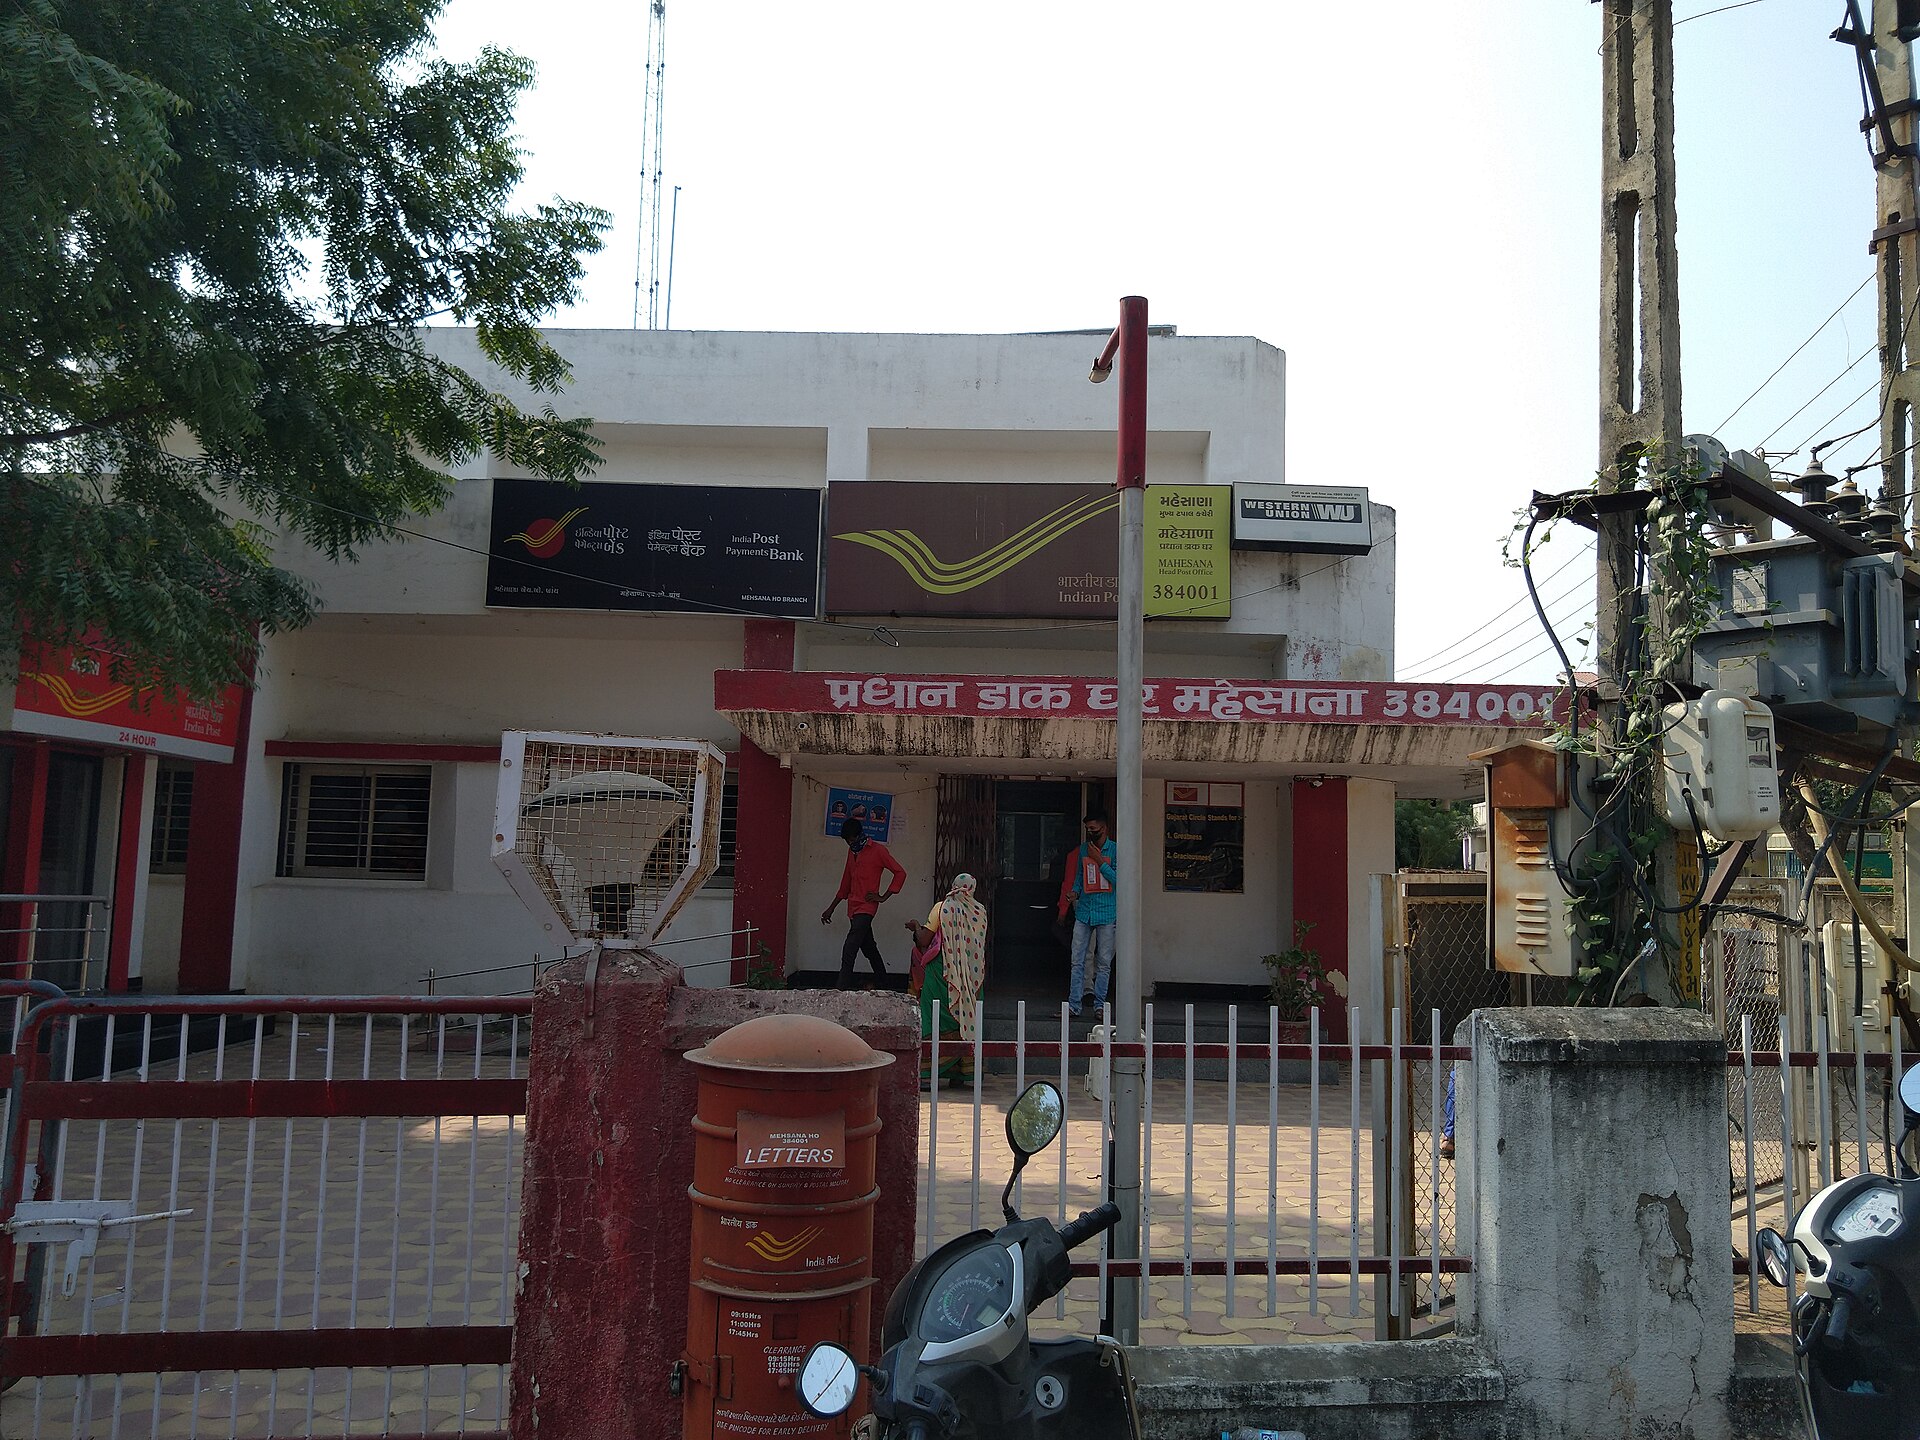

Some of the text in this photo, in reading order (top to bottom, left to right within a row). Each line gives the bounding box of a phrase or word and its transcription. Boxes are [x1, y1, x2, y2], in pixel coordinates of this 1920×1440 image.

[1160, 492, 1213, 507] મહેસાણા
[1244, 501, 1310, 511] WESTERN
[1265, 510, 1310, 519] UNION
[1318, 504, 1355, 520] WU
[603, 524, 629, 538] પોસ્ટ
[648, 526, 702, 541] इंडिया पोस्ट
[1158, 524, 1214, 540] महेसाणा
[732, 532, 780, 545] India Post
[680, 540, 706, 557] बैंक
[725, 547, 804, 562] Payments Bank
[1158, 558, 1214, 569] MAHESANA
[1158, 568, 1213, 576] Head Post Office
[1058, 572, 1119, 587] भारतीय डा
[741, 594, 770, 602] MEHSANA
[1059, 591, 1119, 603] Indian Po
[1153, 584, 1219, 600] 384001
[824, 677, 964, 710] प्रधान
[976, 682, 1073, 710] डाक
[1173, 678, 1369, 720] महेसाना
[1382, 690, 1554, 721] 384001
[184, 719, 221, 737] India Post
[119, 731, 157, 747] 24 HOUR
[1173, 870, 1189, 880] Glory
[1682, 874, 1696, 892] KV
[744, 1148, 834, 1164] LETTERS
[720, 1215, 743, 1229] भारतीय
[806, 1255, 840, 1267] India Post
[730, 1311, 761, 1320] 09:15Hrs
[730, 1320, 761, 1328] 11:00Hrs
[728, 1328, 759, 1338] 17:45Hrs
[763, 1345, 807, 1354] CLEARANCE
[716, 1420, 830, 1435] USE PINCODE FOR EARLY DELIVERY
